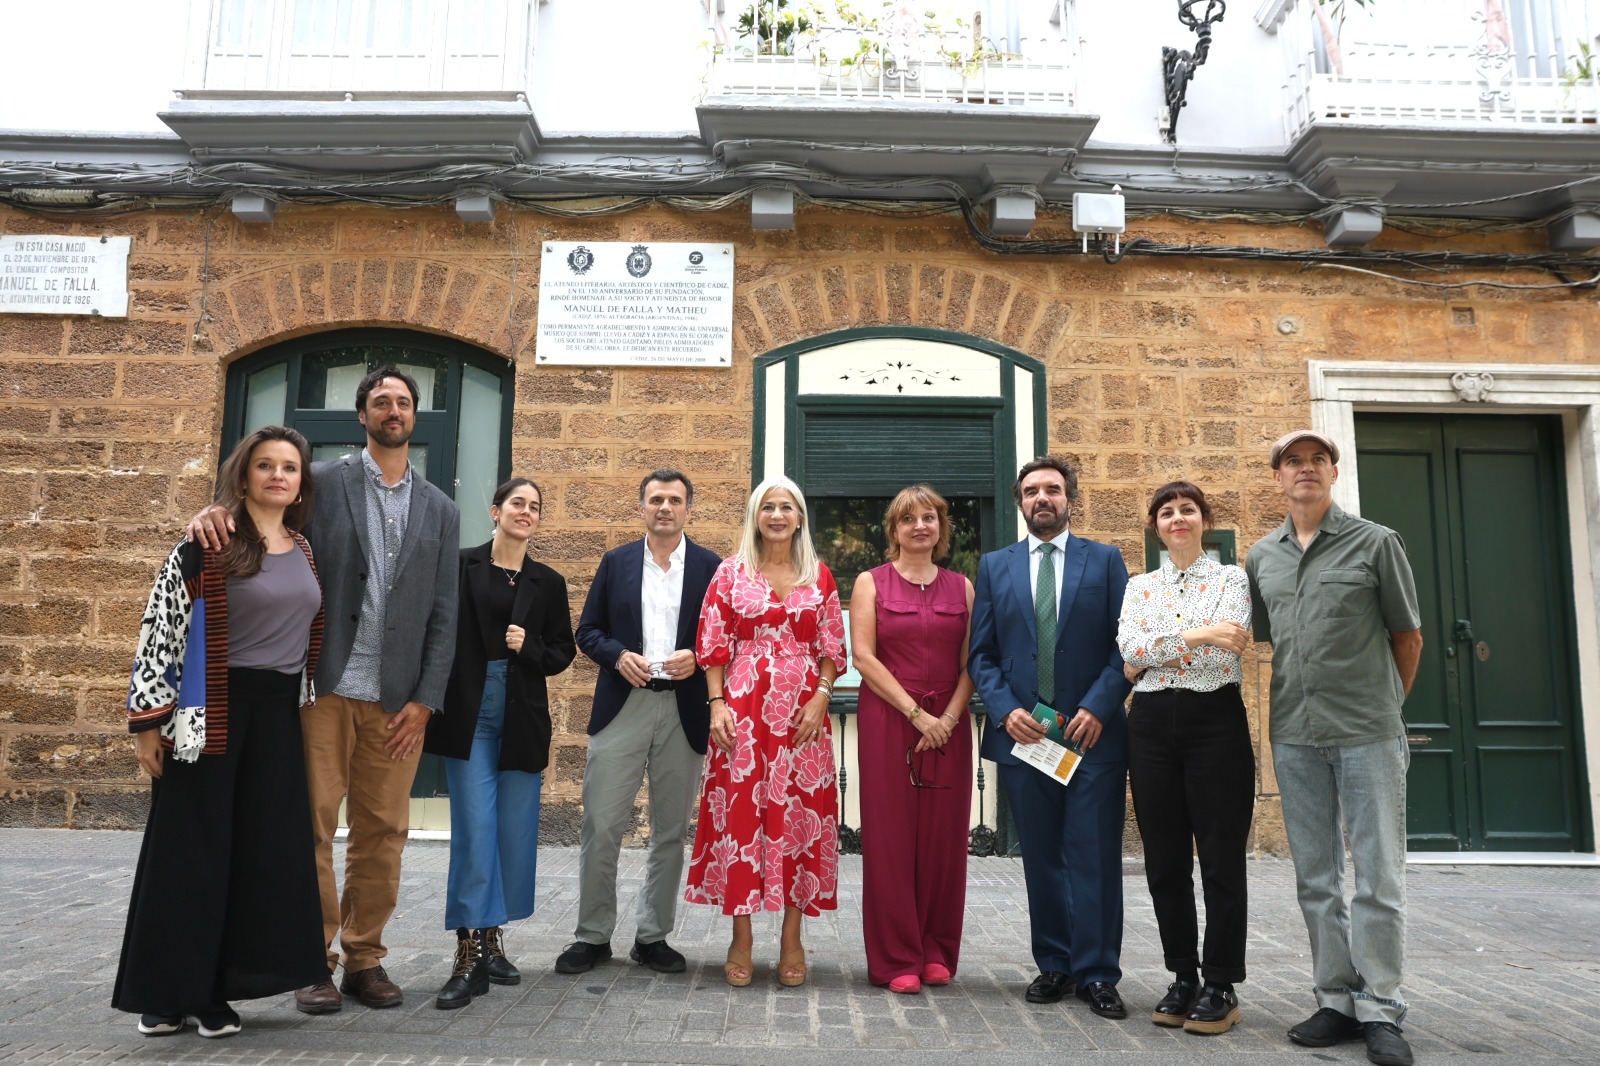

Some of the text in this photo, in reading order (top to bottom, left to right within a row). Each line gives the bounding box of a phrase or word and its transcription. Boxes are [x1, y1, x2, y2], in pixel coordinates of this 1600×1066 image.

[15, 242, 24, 251] EN
[26, 242, 42, 251] ESTA
[46, 242, 62, 252] CASA
[44, 279, 58, 291] DE
[64, 278, 100, 291] FALLA.
[10, 295, 59, 304] AYUNTAMIENTO
[63, 296, 71, 304] DE
